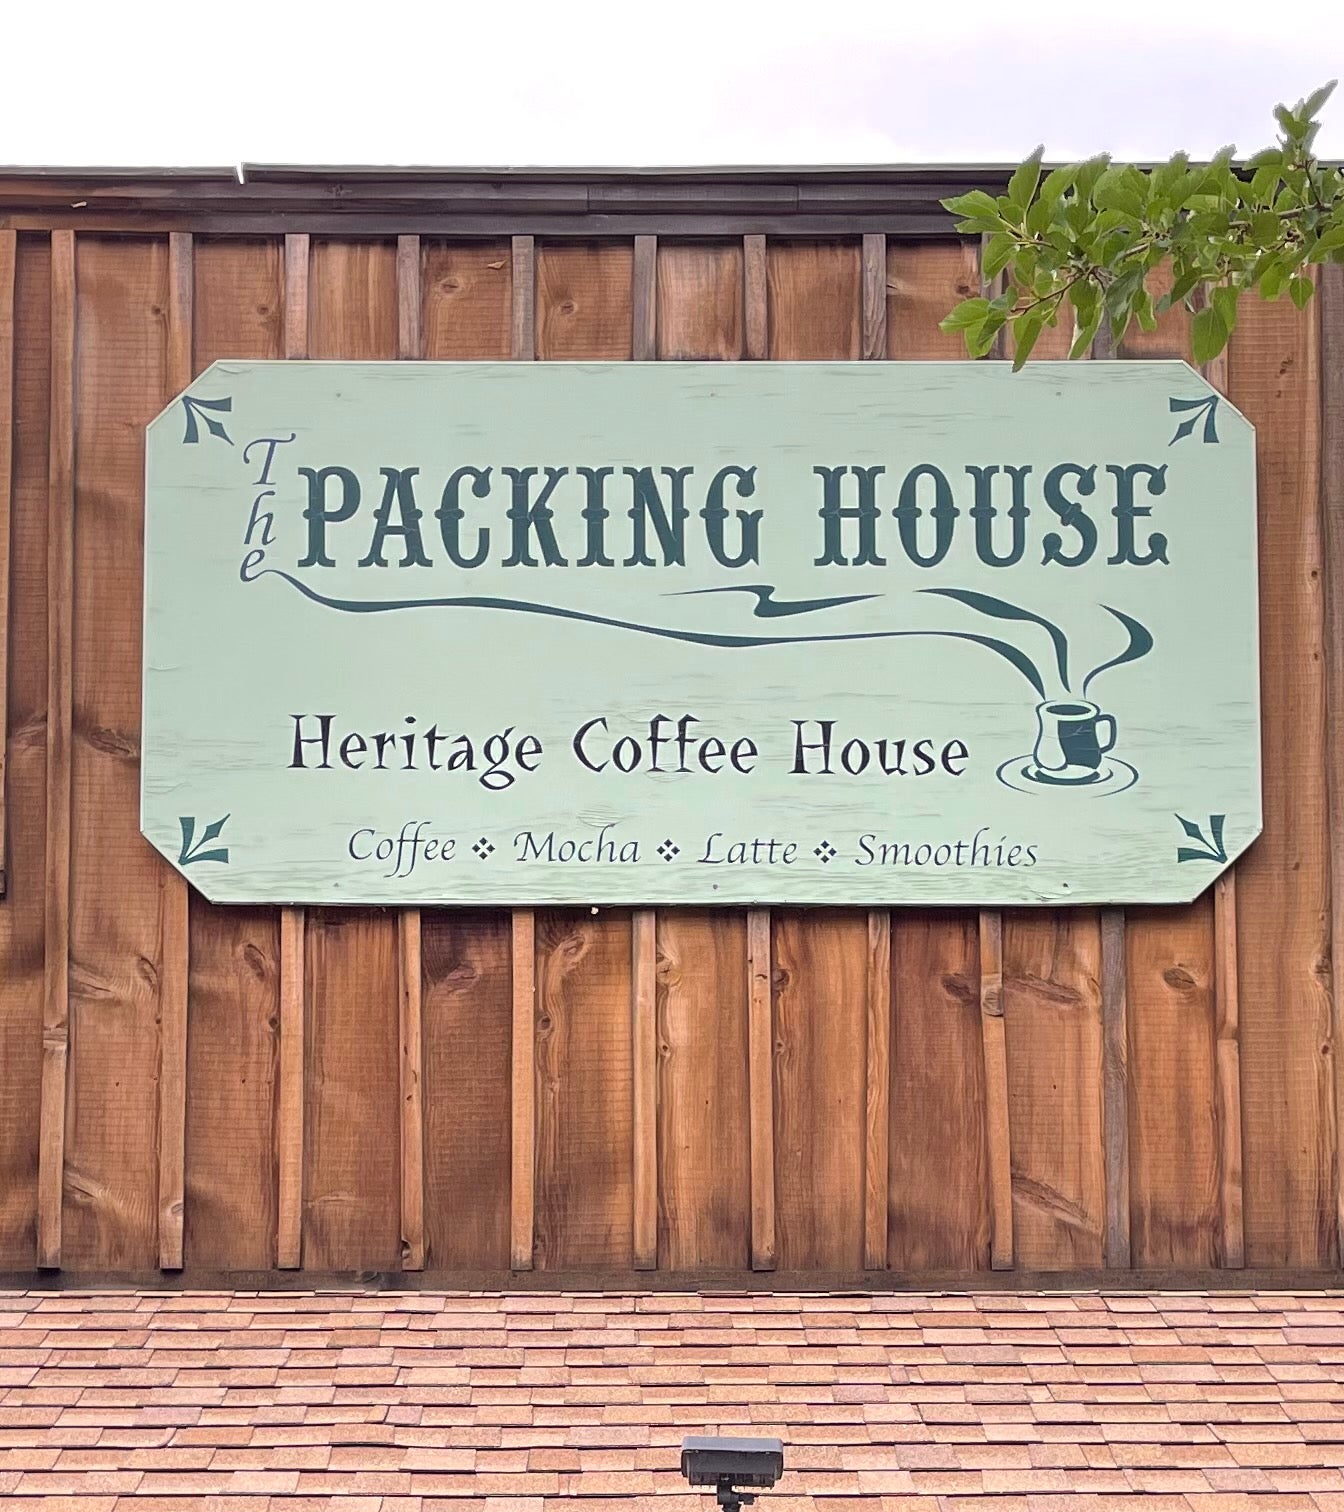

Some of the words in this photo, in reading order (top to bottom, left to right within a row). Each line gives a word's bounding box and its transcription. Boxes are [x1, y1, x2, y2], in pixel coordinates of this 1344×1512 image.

[241, 433, 296, 583] The
[297, 464, 761, 569] PACKING
[813, 463, 1171, 567] HOUSE
[287, 713, 544, 791] Heritage
[572, 712, 759, 776] Coffee
[788, 719, 970, 778] House
[347, 821, 458, 879] Coffee
[511, 828, 642, 868] Mocha
[698, 831, 799, 868] Latte
[854, 831, 1040, 870] Smoothies
